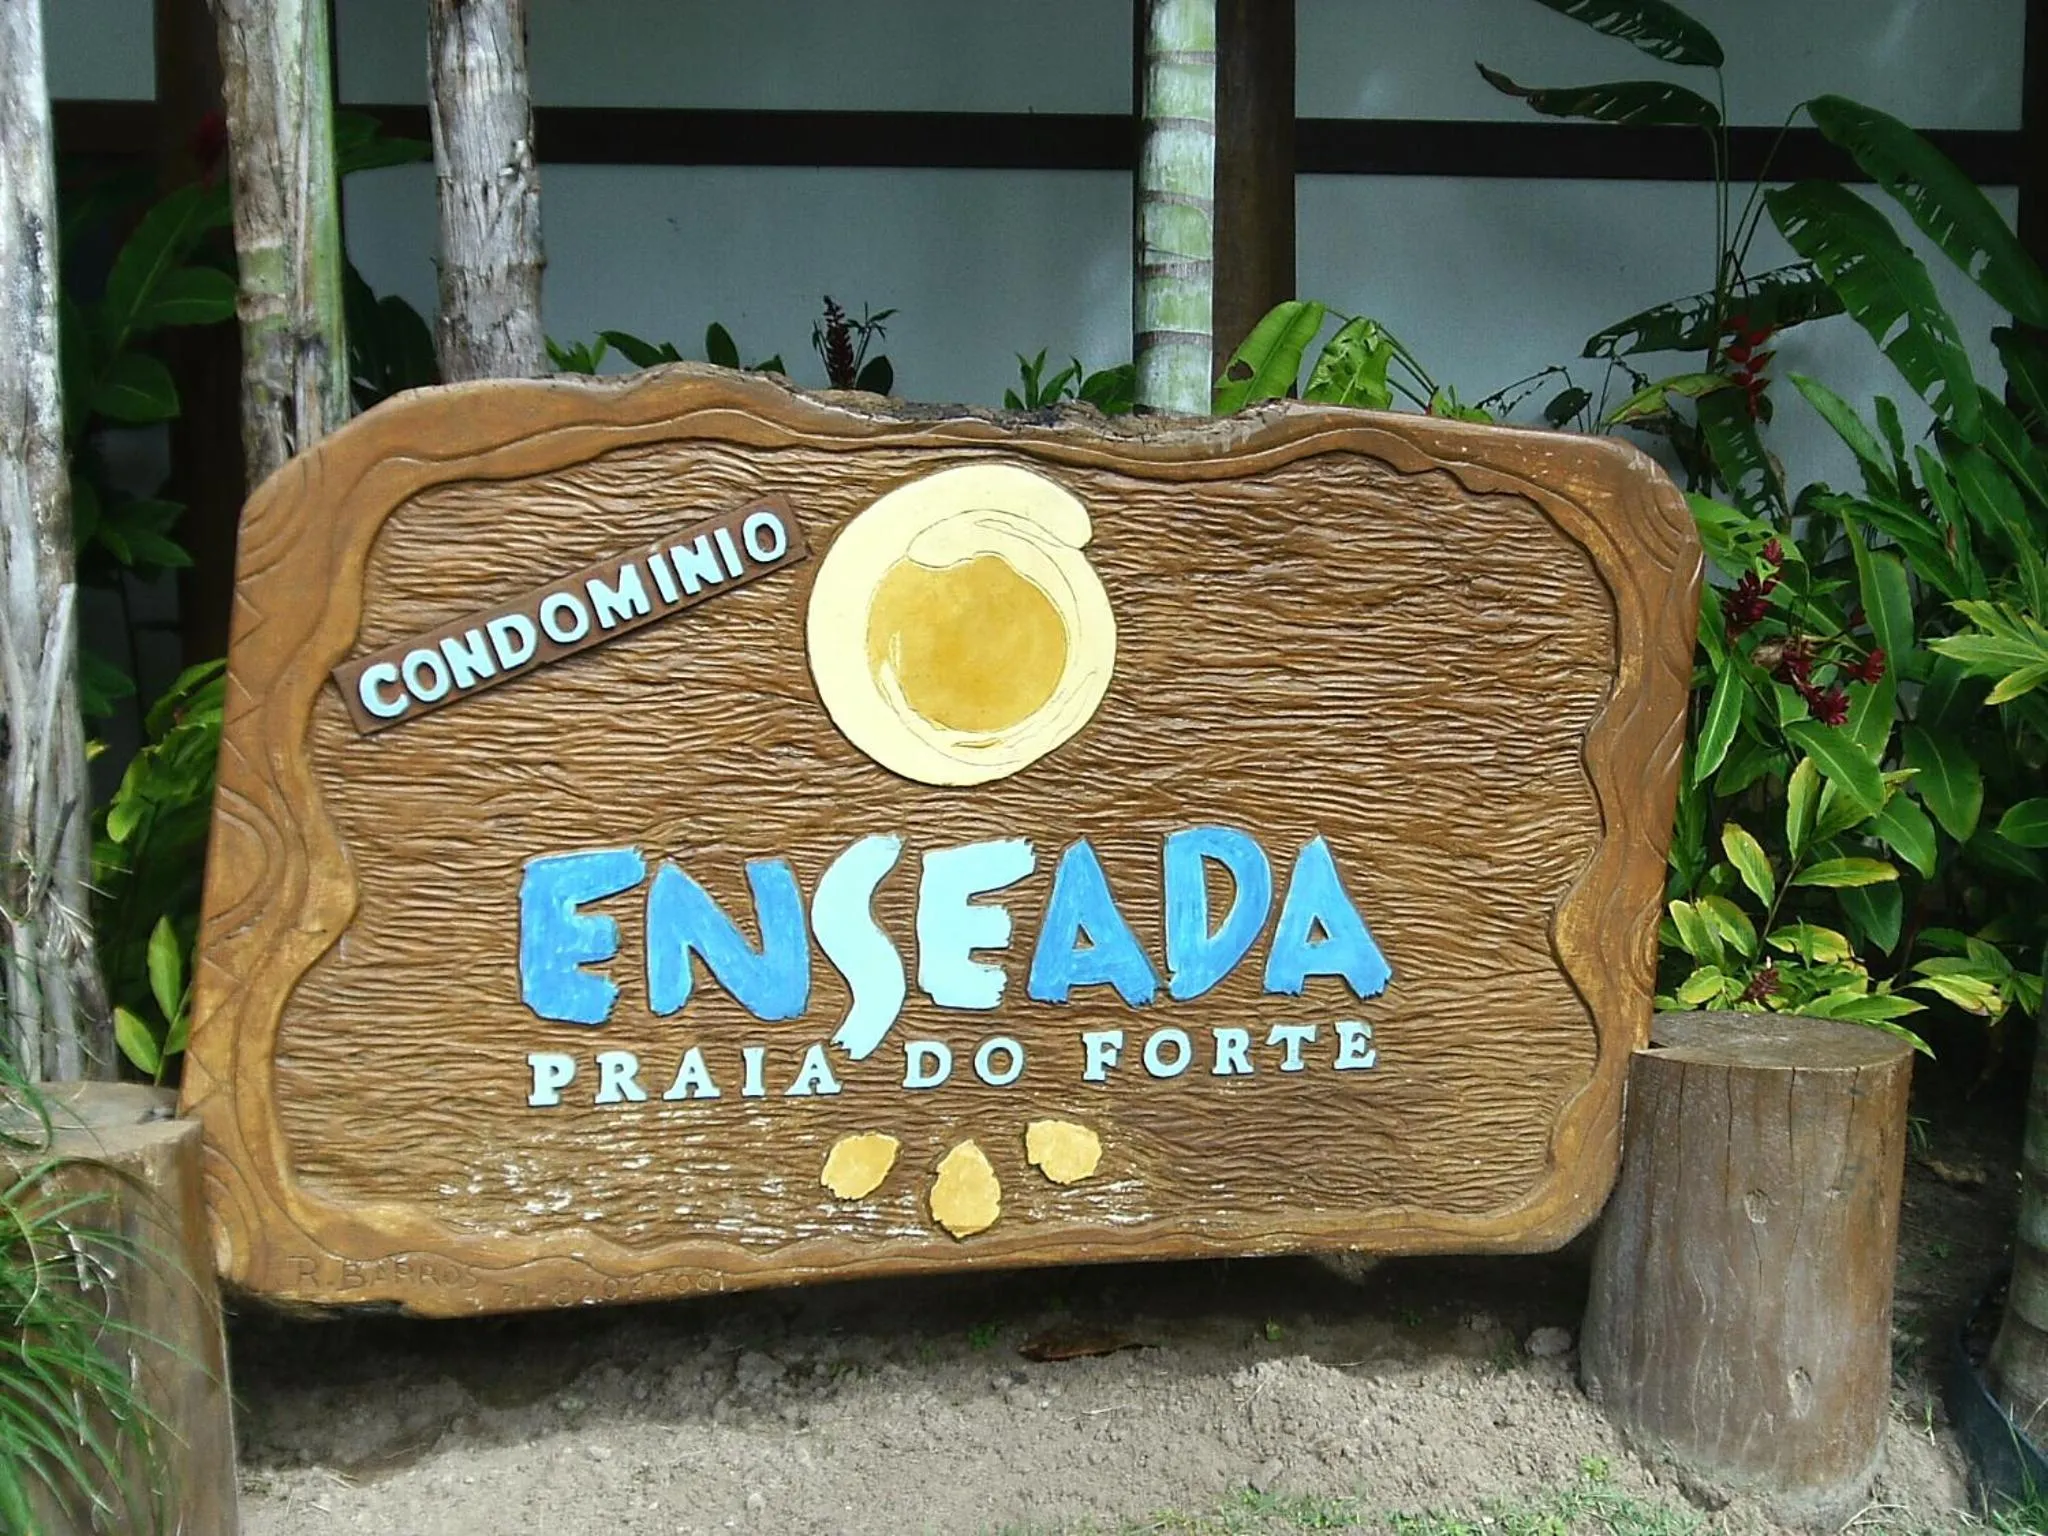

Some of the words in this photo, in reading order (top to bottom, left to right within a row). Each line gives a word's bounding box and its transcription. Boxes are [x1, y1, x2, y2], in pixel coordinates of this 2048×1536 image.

[519, 825, 1393, 1060] ENSEADA
[527, 1043, 844, 1107] PRAIA
[902, 1036, 1025, 1090] DO
[1081, 1019, 1377, 1081] FORTE
